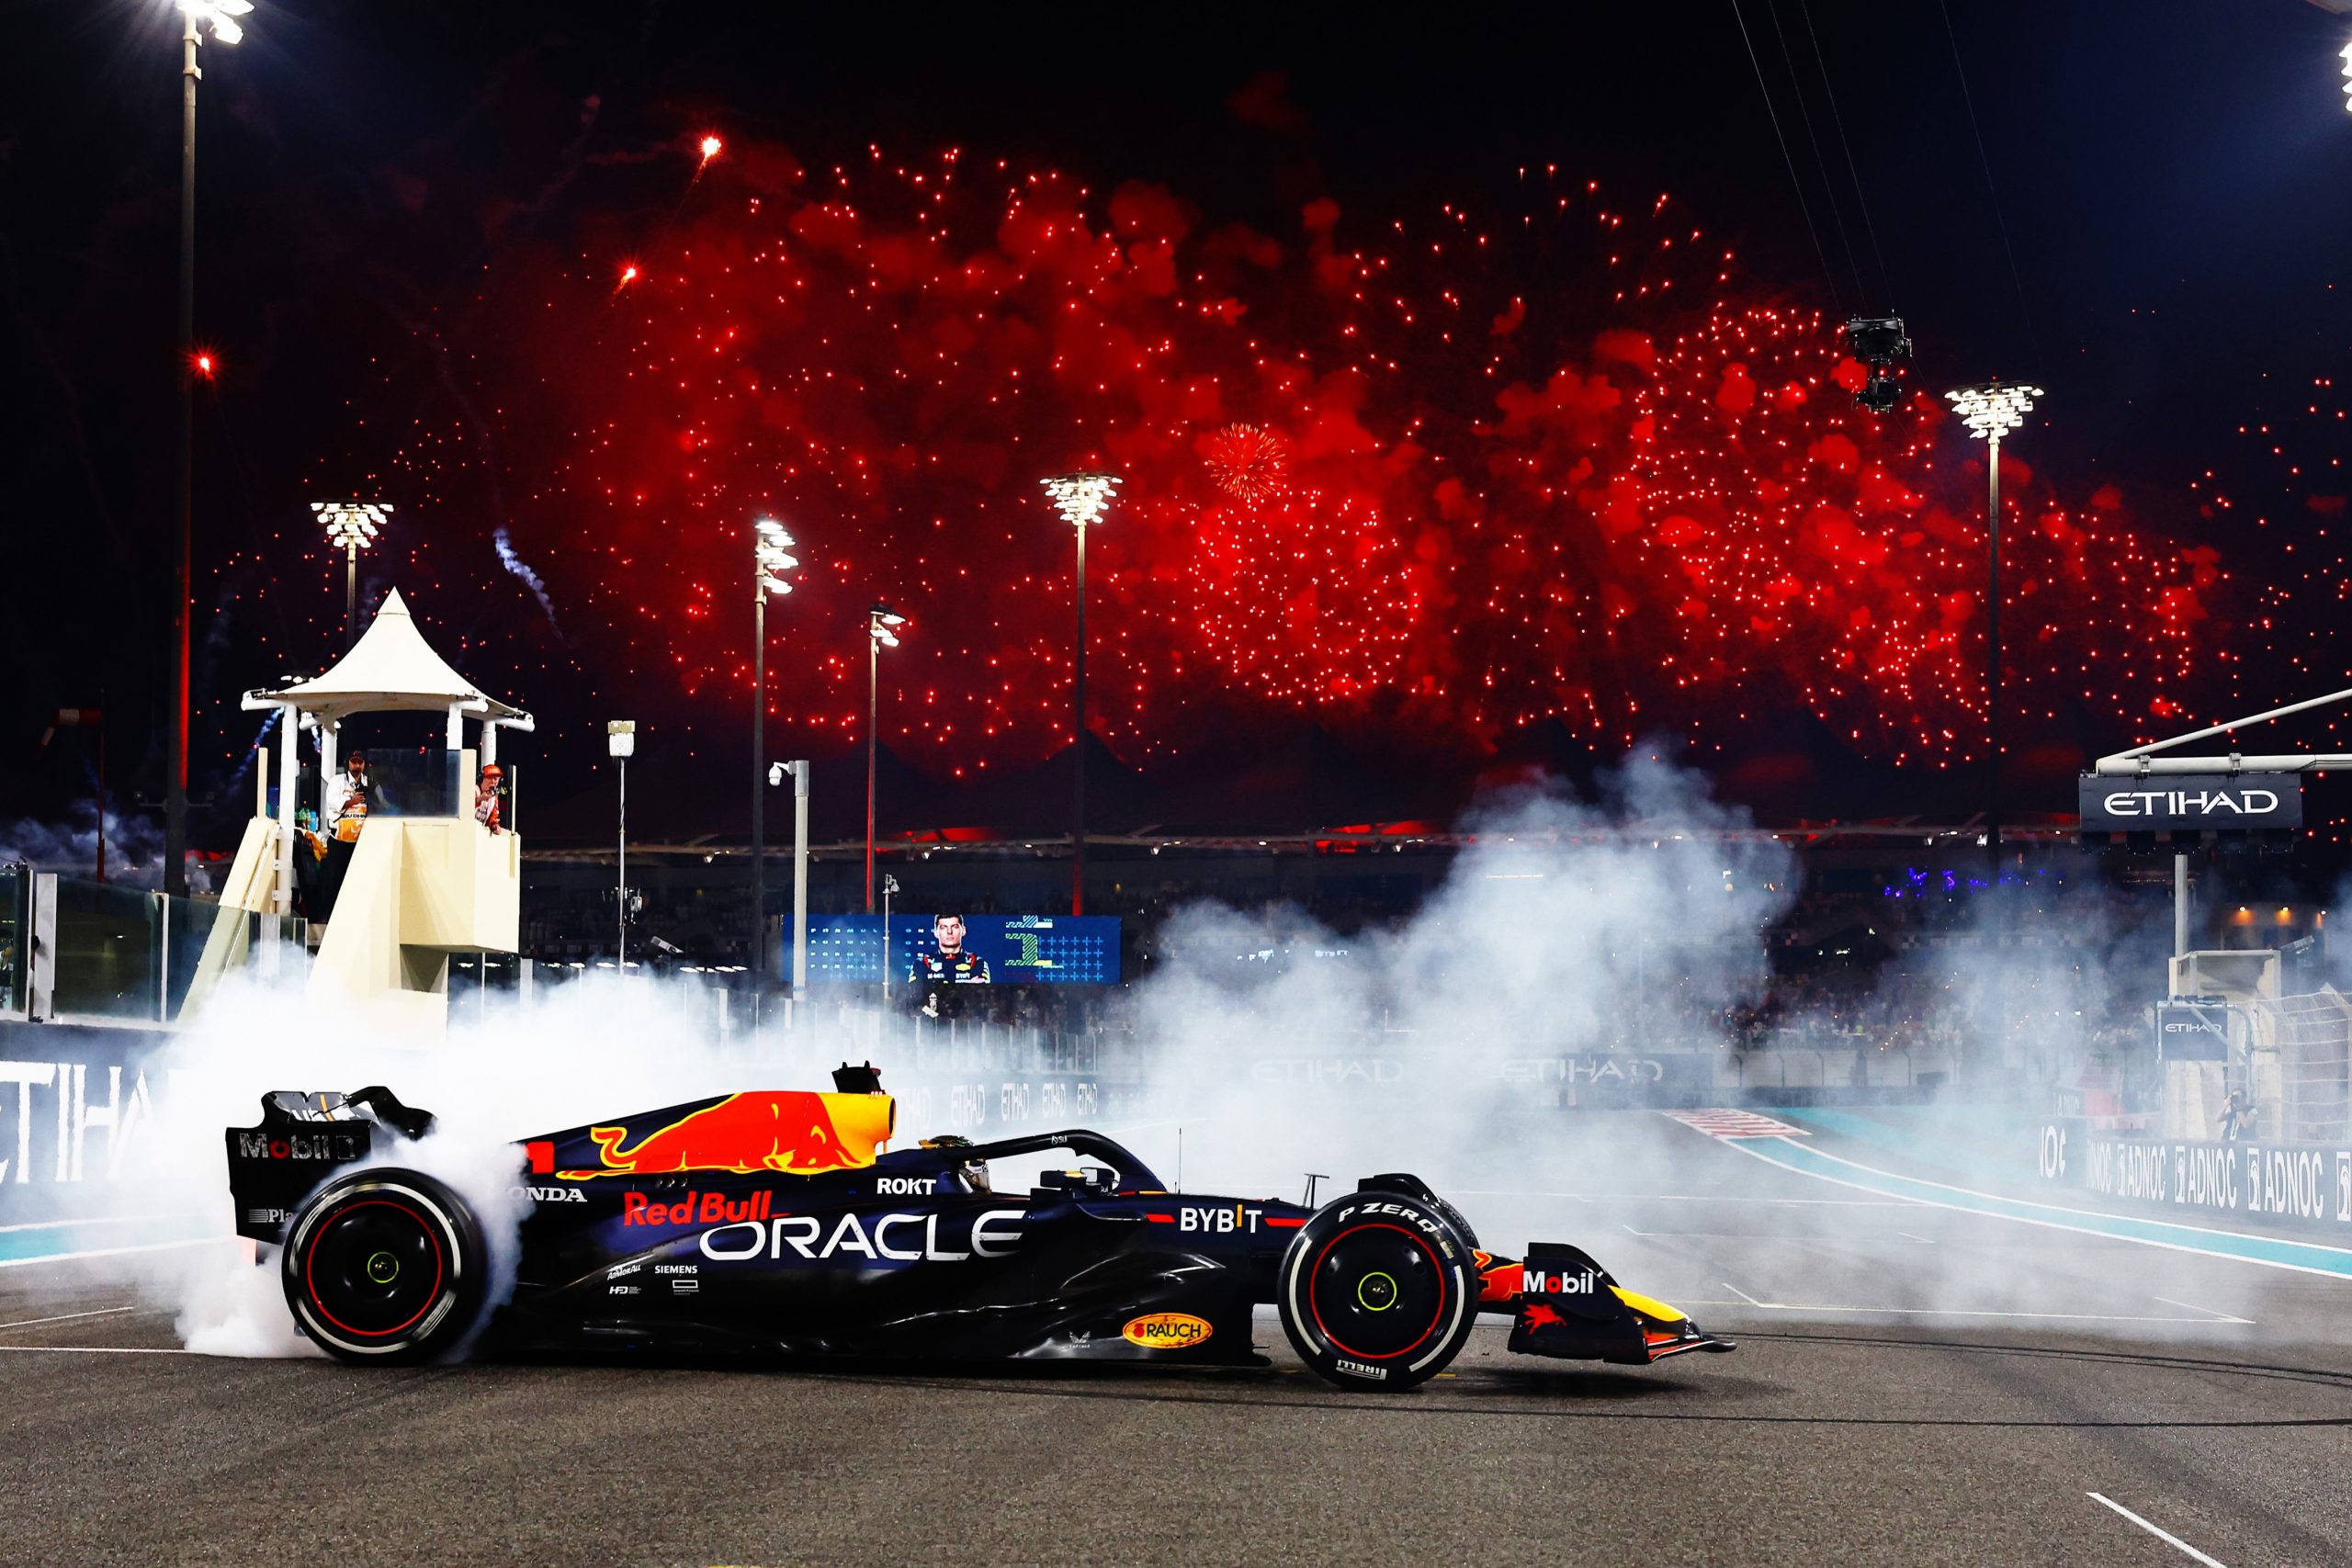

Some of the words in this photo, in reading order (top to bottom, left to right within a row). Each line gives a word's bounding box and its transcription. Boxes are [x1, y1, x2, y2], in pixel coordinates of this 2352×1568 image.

[2104, 790, 2278, 817] ETIHAD
[2165, 1023, 2222, 1032] ETIHAD
[1251, 1059, 1404, 1083] ETIHAD
[1499, 1059, 1663, 1083] ETIHAD
[897, 1087, 931, 1131] TIHAD
[950, 1084, 985, 1125] ETIHAD
[1001, 1083, 1029, 1121] ETIHAD
[1042, 1083, 1066, 1117] ETIHAD
[1077, 1083, 1097, 1116] ETIHAD
[239, 1133, 331, 1159] Mobil
[877, 1178, 936, 1196] ROKT
[2128, 1145, 2166, 1201] ADNOC
[2188, 1148, 2237, 1209] ADNOC
[2265, 1151, 2324, 1219] ADNOC
[505, 1187, 588, 1202] ONDA
[267, 1209, 298, 1224] Pla
[624, 1190, 697, 1226] Red
[698, 1190, 772, 1224] Bull
[1181, 1204, 1262, 1234] BYBIT
[1339, 1206, 1356, 1223] P
[1361, 1202, 1440, 1233] ZERO
[700, 1209, 1027, 1261] ORACLE
[654, 1265, 698, 1275] SIEMENS
[1523, 1270, 1594, 1294] Mobil
[1147, 1324, 1202, 1338] RAUCH
[1336, 1359, 1387, 1381] PIRELLI
